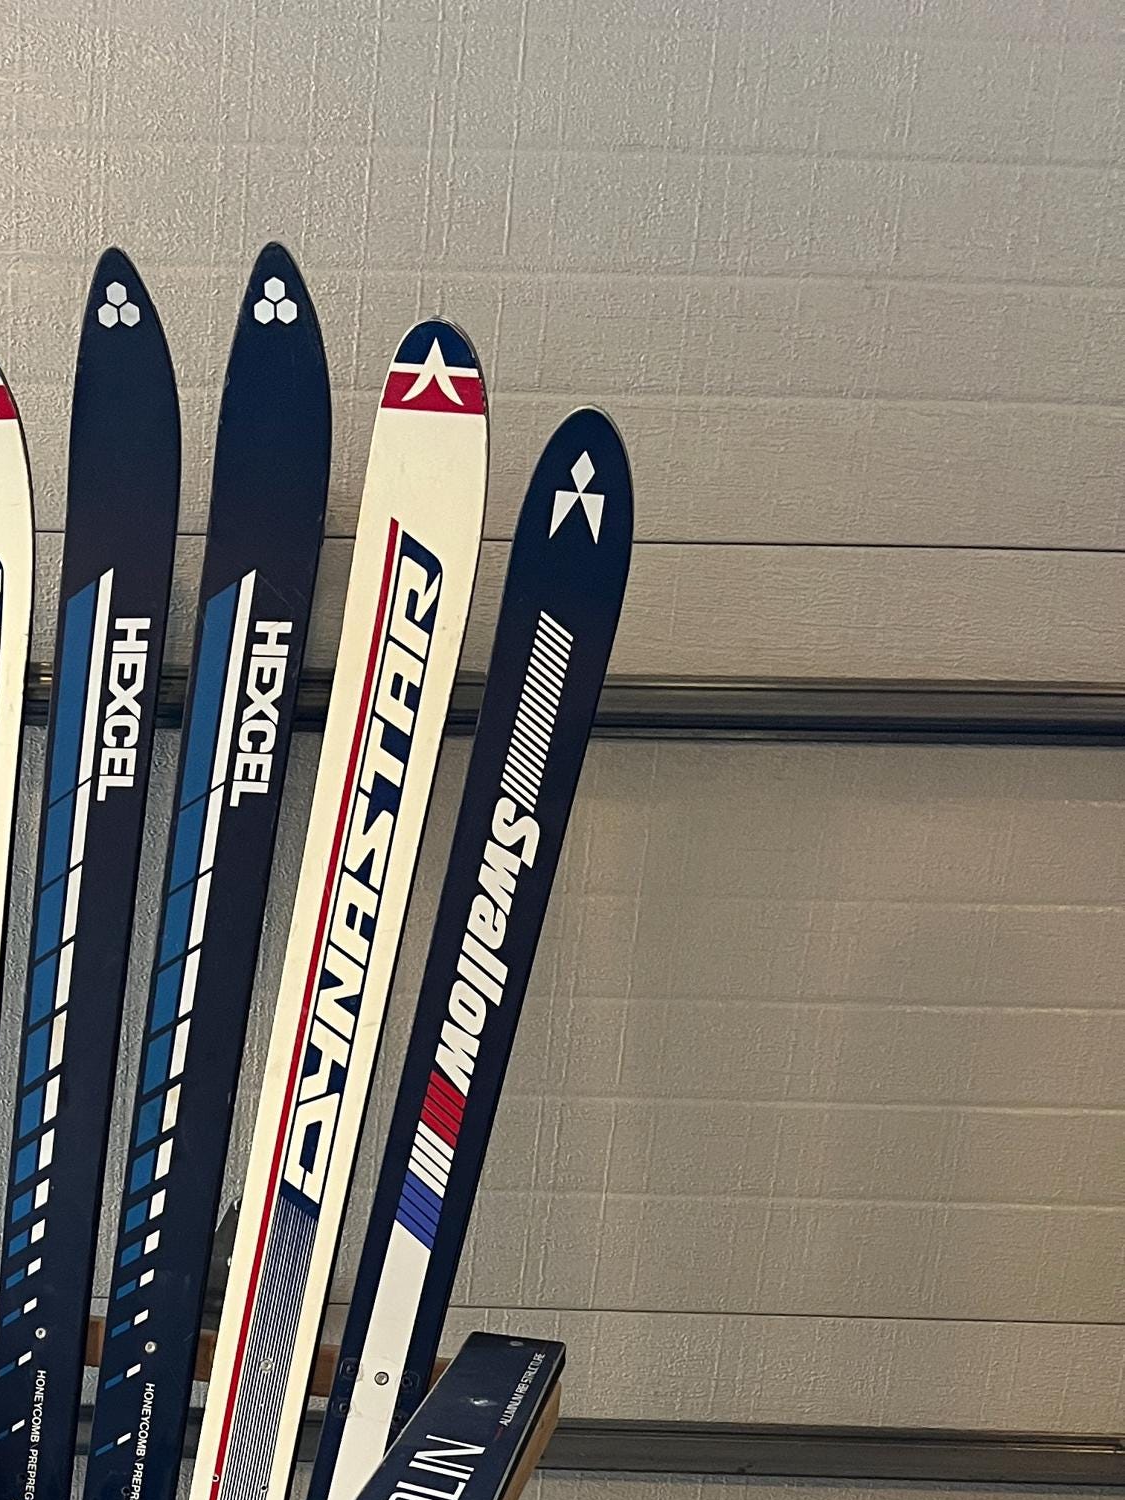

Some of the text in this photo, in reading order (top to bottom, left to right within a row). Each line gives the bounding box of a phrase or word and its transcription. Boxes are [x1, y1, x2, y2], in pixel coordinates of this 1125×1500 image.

[98, 617, 152, 801] HEXCEL
[229, 621, 293, 807] HEXCEL
[285, 550, 443, 1204] DYNASTAR
[437, 810, 542, 1096] Swallow
[24, 1369, 47, 1500] HONEYCOMB PREPREG
[135, 1382, 156, 1457] HONEYCOMB
